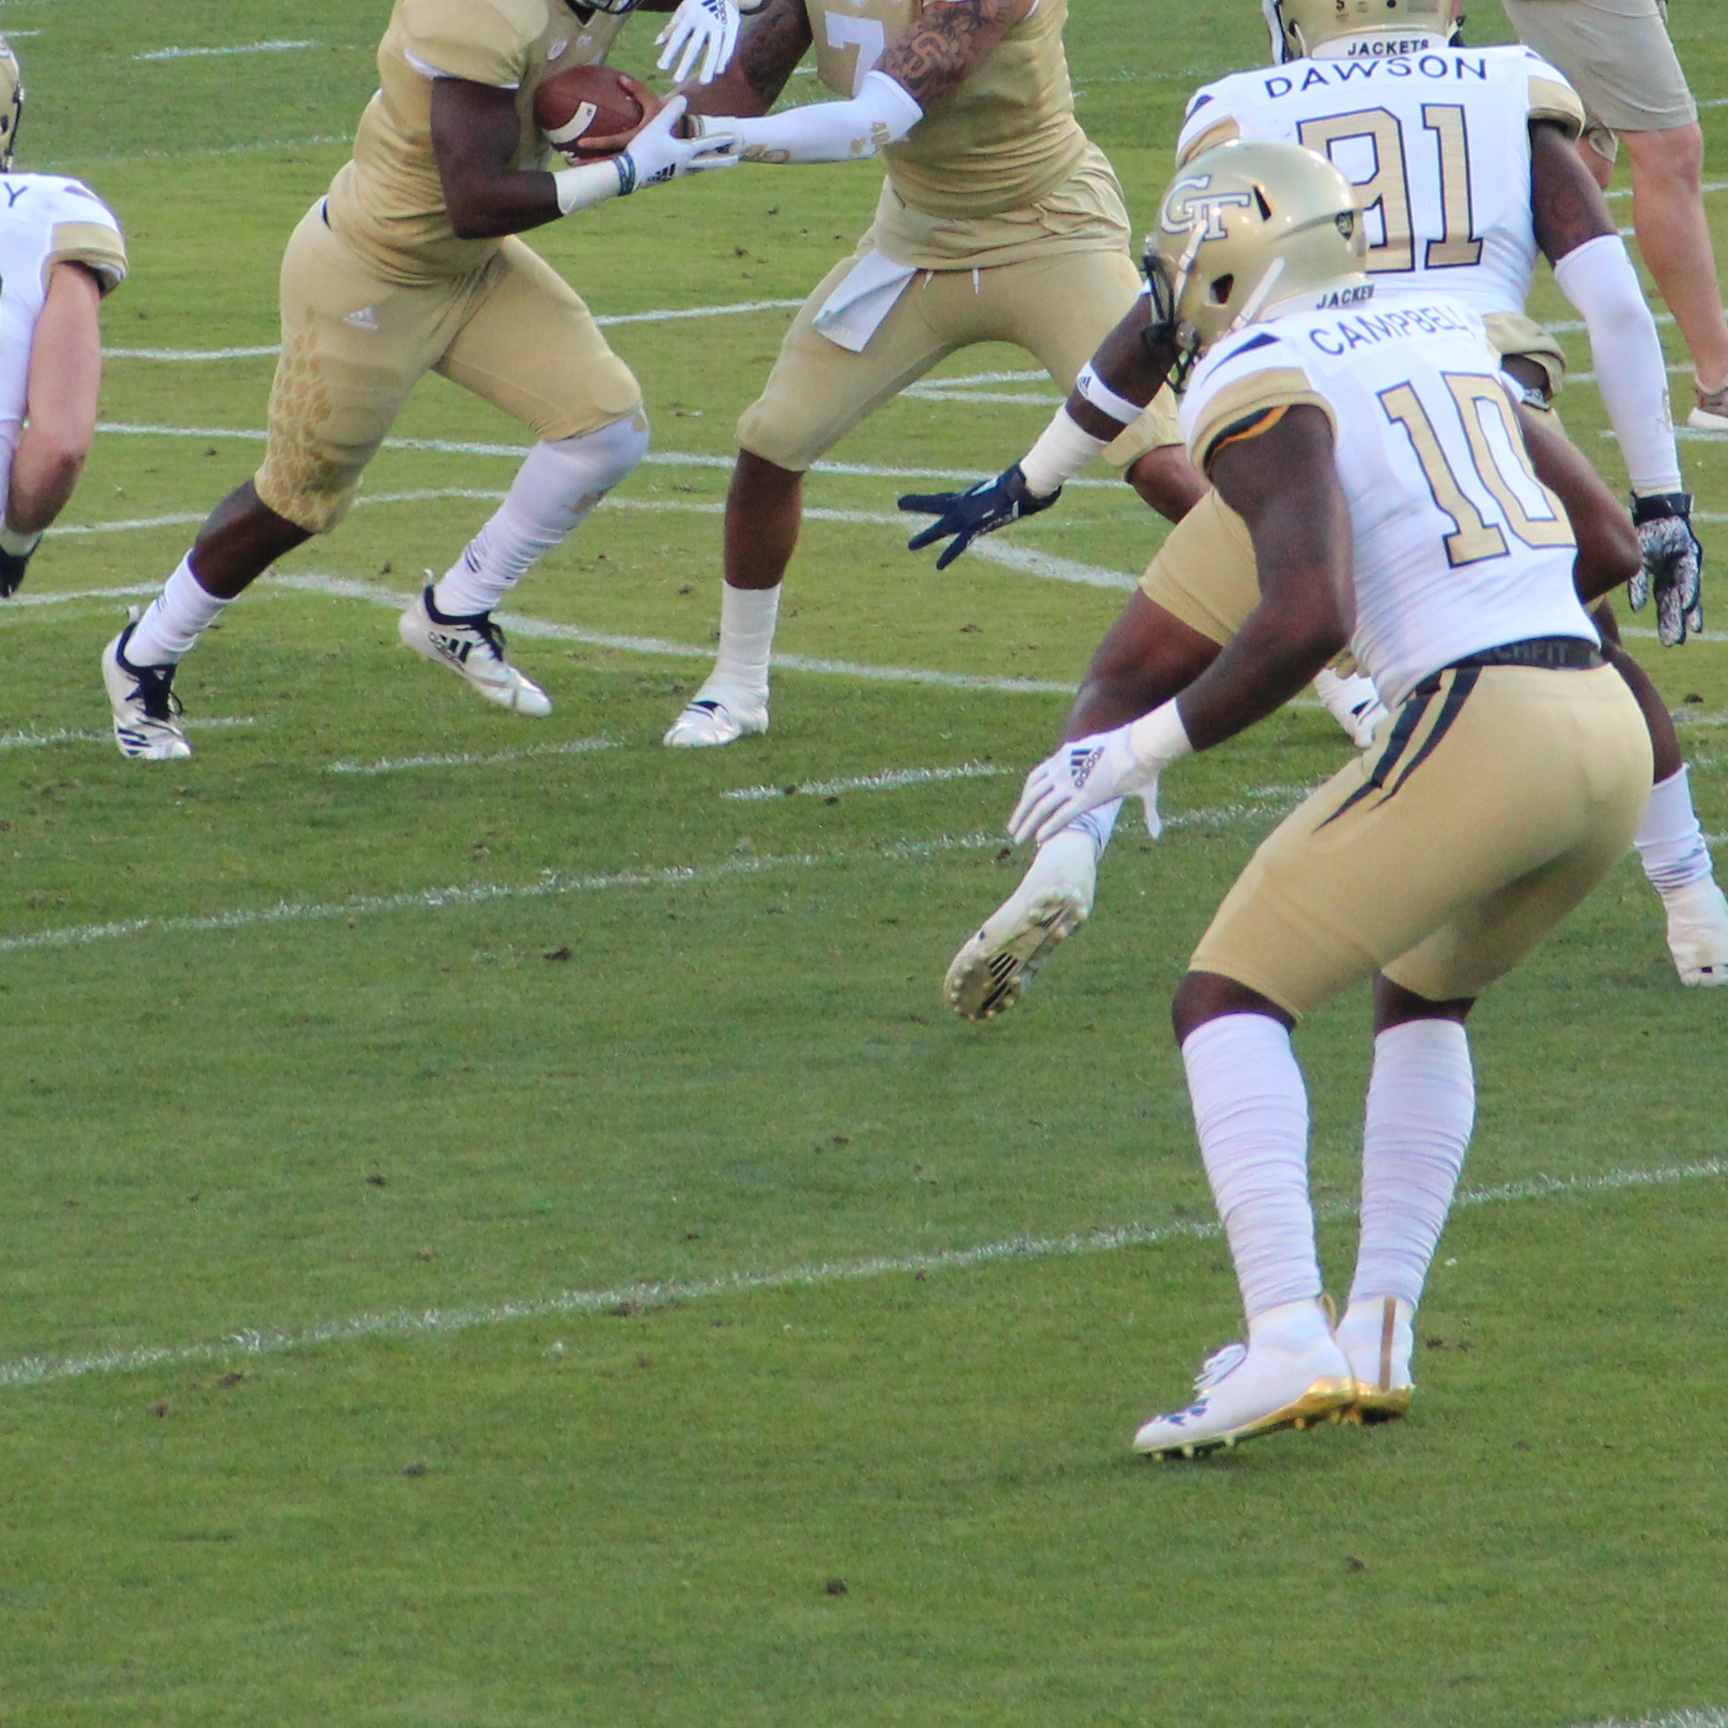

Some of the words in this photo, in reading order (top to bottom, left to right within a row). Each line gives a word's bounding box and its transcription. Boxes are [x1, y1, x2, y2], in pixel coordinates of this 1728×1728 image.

[824, 10, 885, 106] 7
[1264, 55, 1488, 100] DAWSON
[1347, 39, 1430, 58] JACKETS
[1160, 174, 1253, 242] GT
[1296, 102, 1485, 275] 91
[1374, 369, 1580, 571] 10
